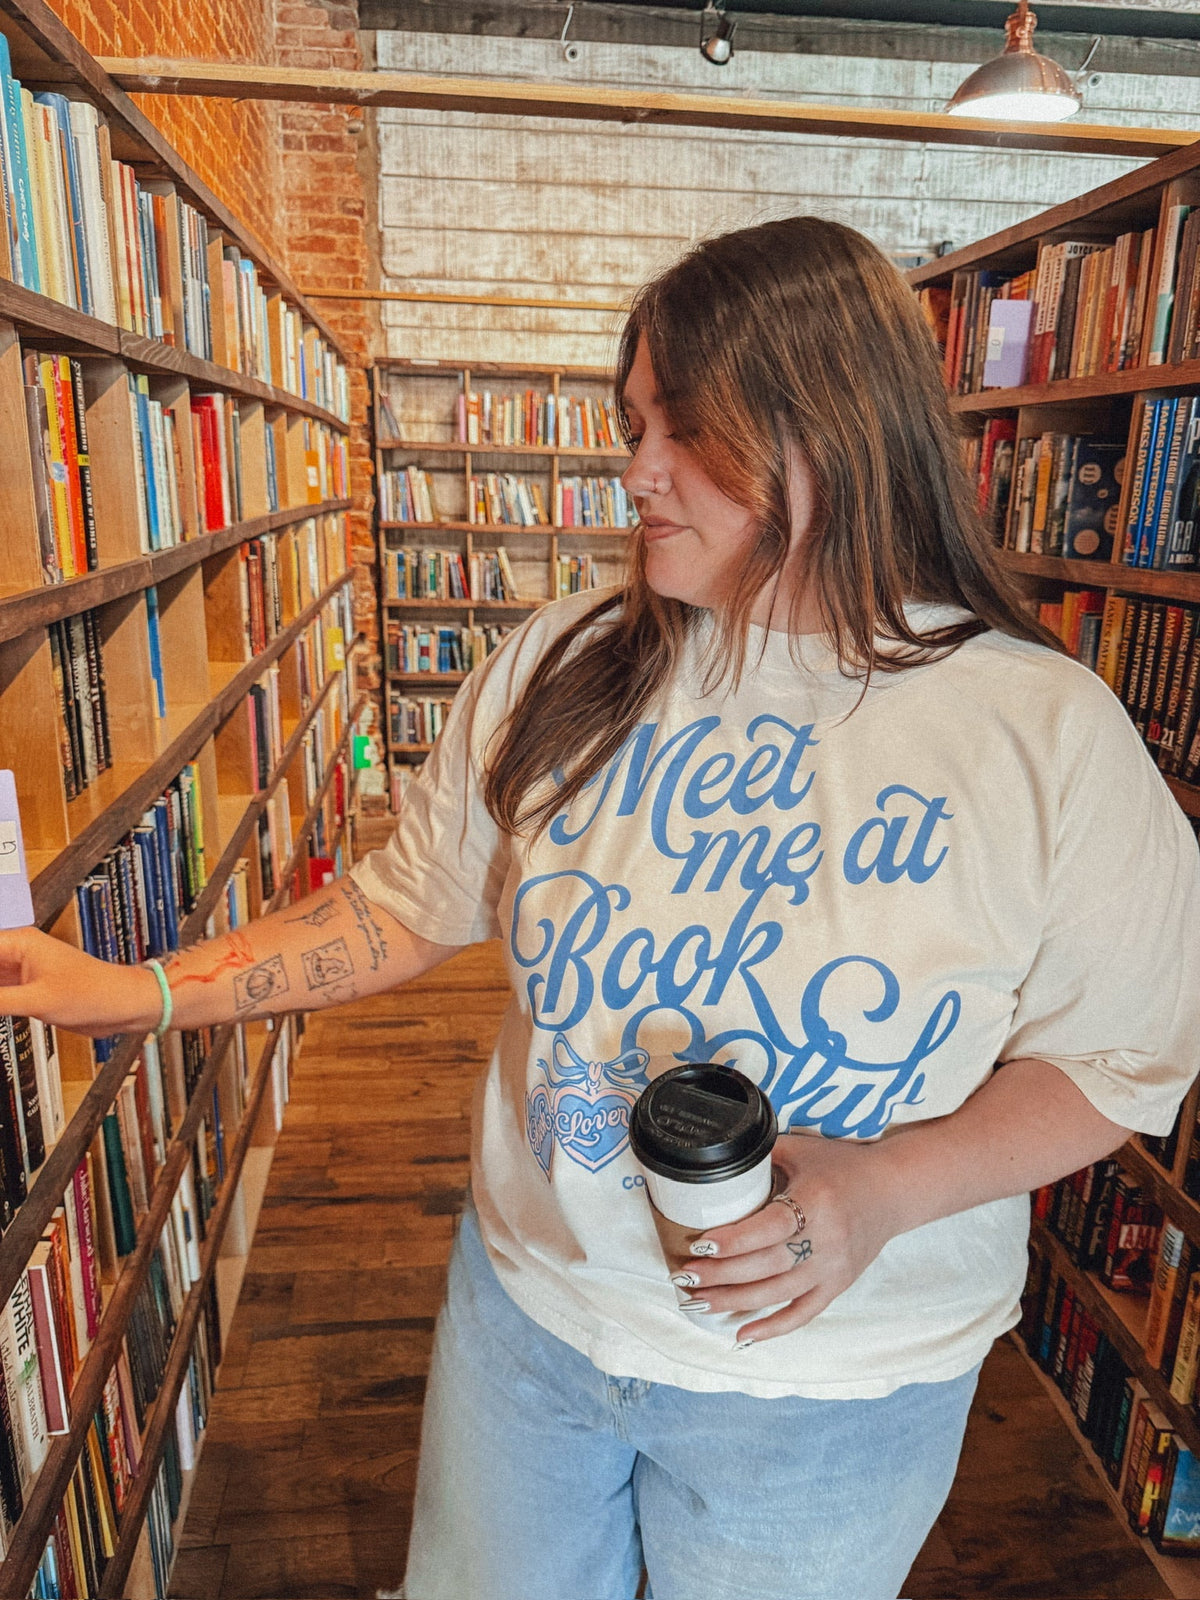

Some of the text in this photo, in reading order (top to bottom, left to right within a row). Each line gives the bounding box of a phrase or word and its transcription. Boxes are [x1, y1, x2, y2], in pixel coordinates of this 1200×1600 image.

[1128, 405, 1154, 525] JAMES PATTERSON
[1144, 405, 1170, 527] JAMES PATTERSON
[1104, 600, 1116, 637] JAMES
[1123, 605, 1136, 638] JAMES
[1127, 609, 1149, 705] JAMES PATTERSON
[1148, 612, 1161, 647] JAMES
[1153, 612, 1177, 711] JAMES PATTERSON
[1168, 616, 1193, 717] JAMES PATTERSON
[1139, 648, 1155, 709] PATTERSON
[1176, 689, 1194, 745] PATTERSON
[549, 714, 821, 860] Meet
[671, 784, 955, 906] me at
[511, 869, 792, 1045] Book
[11, 1284, 30, 1355] WHITE
[25, 1376, 38, 1441] GALBRAITH
